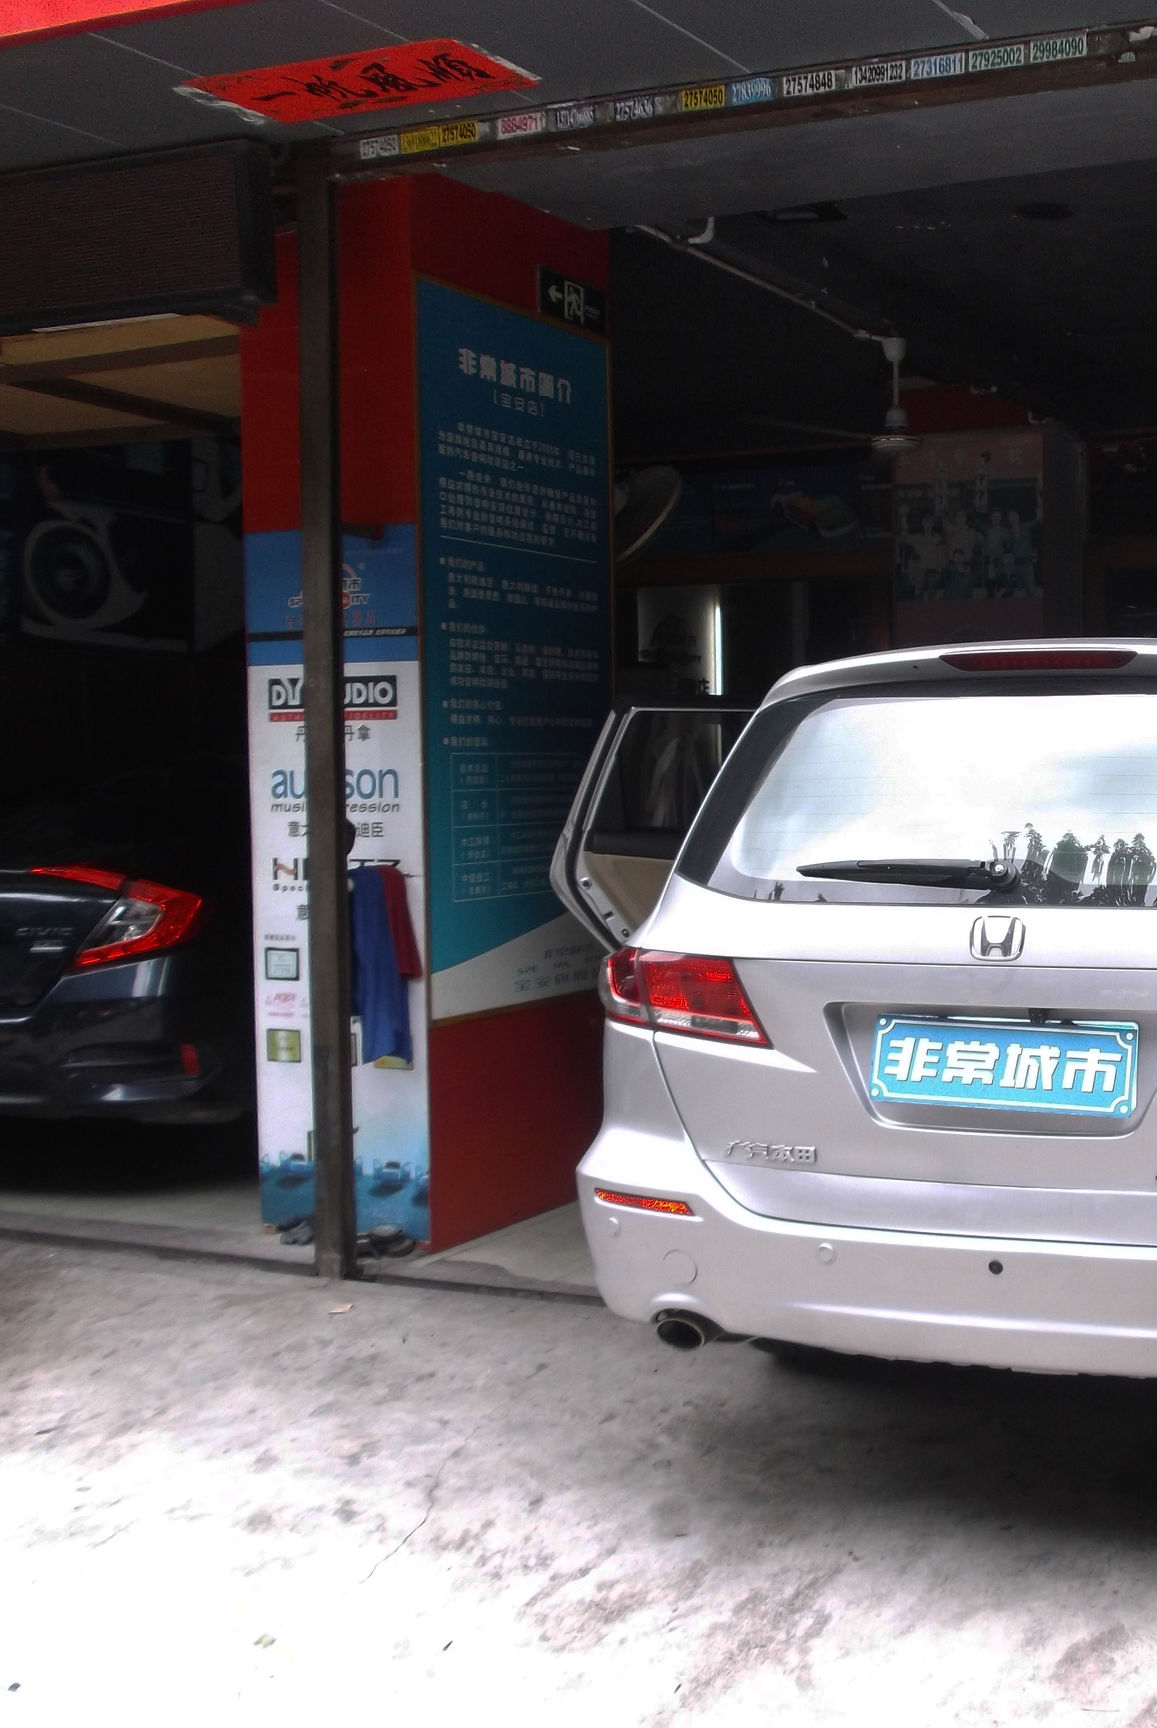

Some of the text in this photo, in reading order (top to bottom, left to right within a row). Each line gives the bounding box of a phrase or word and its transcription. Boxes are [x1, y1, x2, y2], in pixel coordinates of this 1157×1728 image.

[971, 47, 1022, 70] 27925002
[1032, 38, 1084, 61] 29984090
[854, 63, 903, 84] 13420991232
[913, 55, 963, 77] 27316811
[785, 72, 833, 94] 27574848
[683, 88, 724, 109] 27574050
[884, 1037, 1122, 1093] 非常城市
